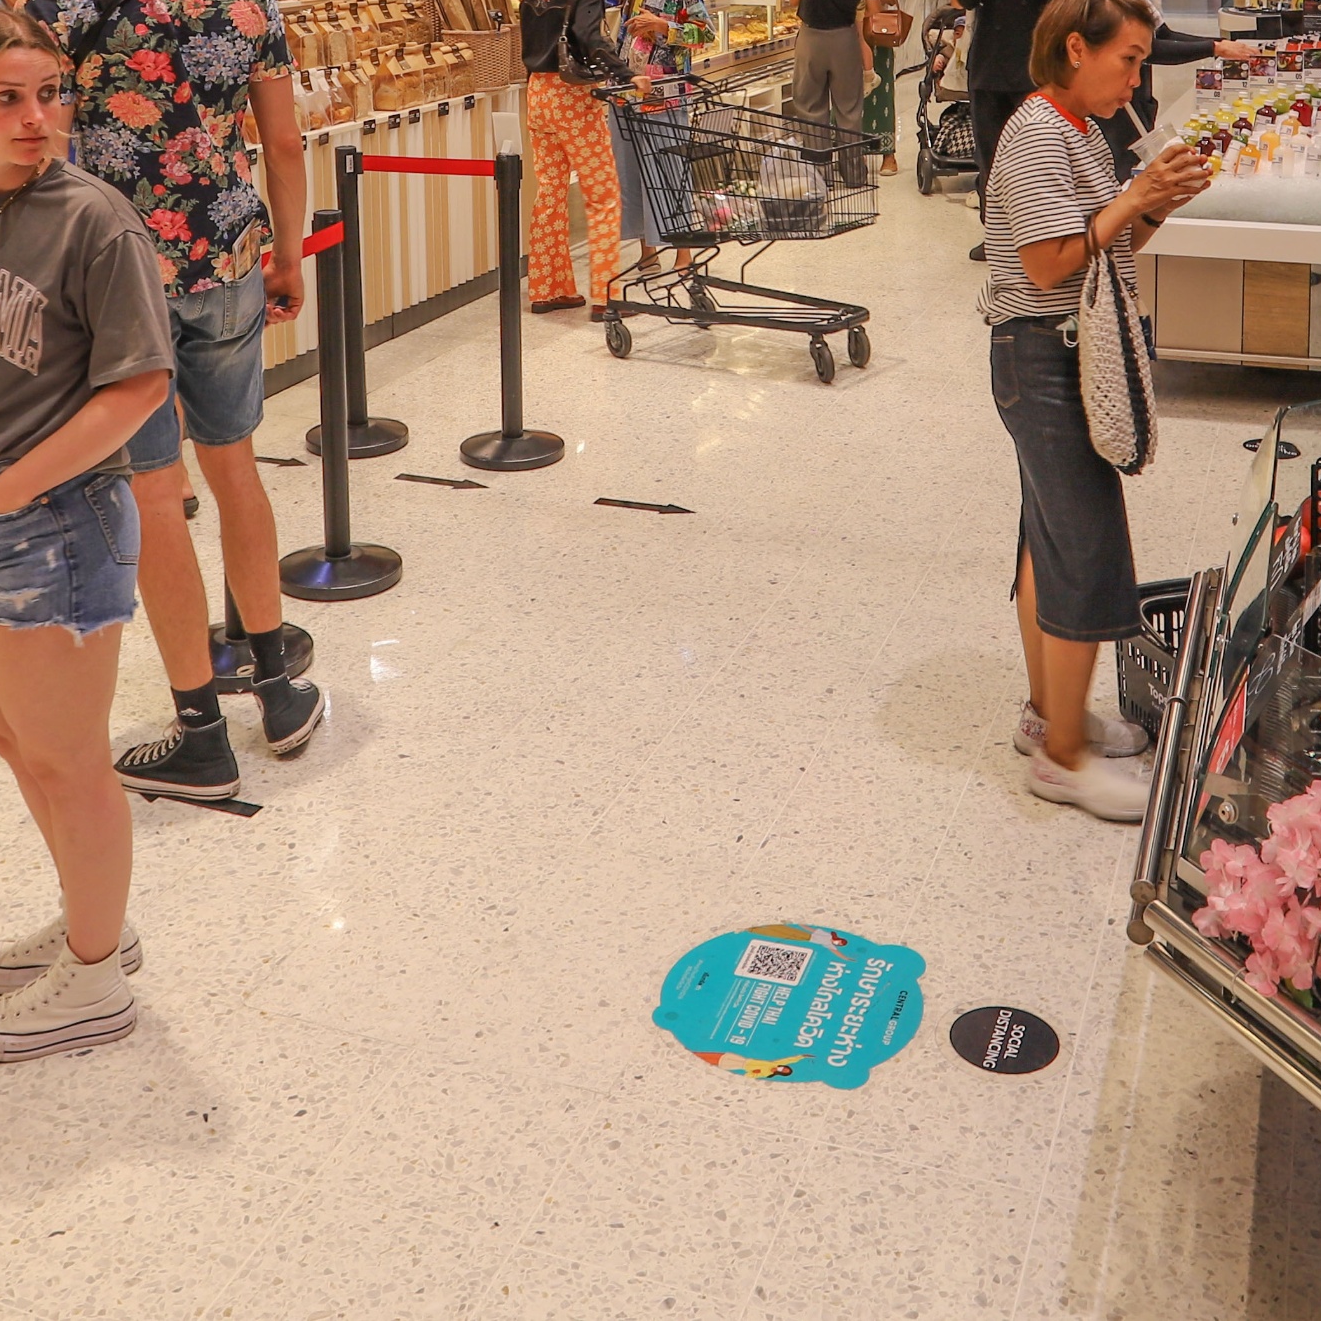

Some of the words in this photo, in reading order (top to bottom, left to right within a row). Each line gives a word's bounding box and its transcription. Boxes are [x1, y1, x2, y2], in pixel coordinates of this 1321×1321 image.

[749, 982, 773, 1004] FIGHT
[772, 985, 793, 1006] HELP
[793, 960, 848, 1048] ห่างไกลโควิด
[737, 1004, 762, 1028] COVID
[761, 1006, 784, 1025] THAI
[826, 957, 893, 1068] รักษาระยะห่าง
[729, 1034, 748, 1046] 19
[982, 1009, 1013, 1069] DISTANCING
[1003, 1023, 1026, 1059] SOCIAL
